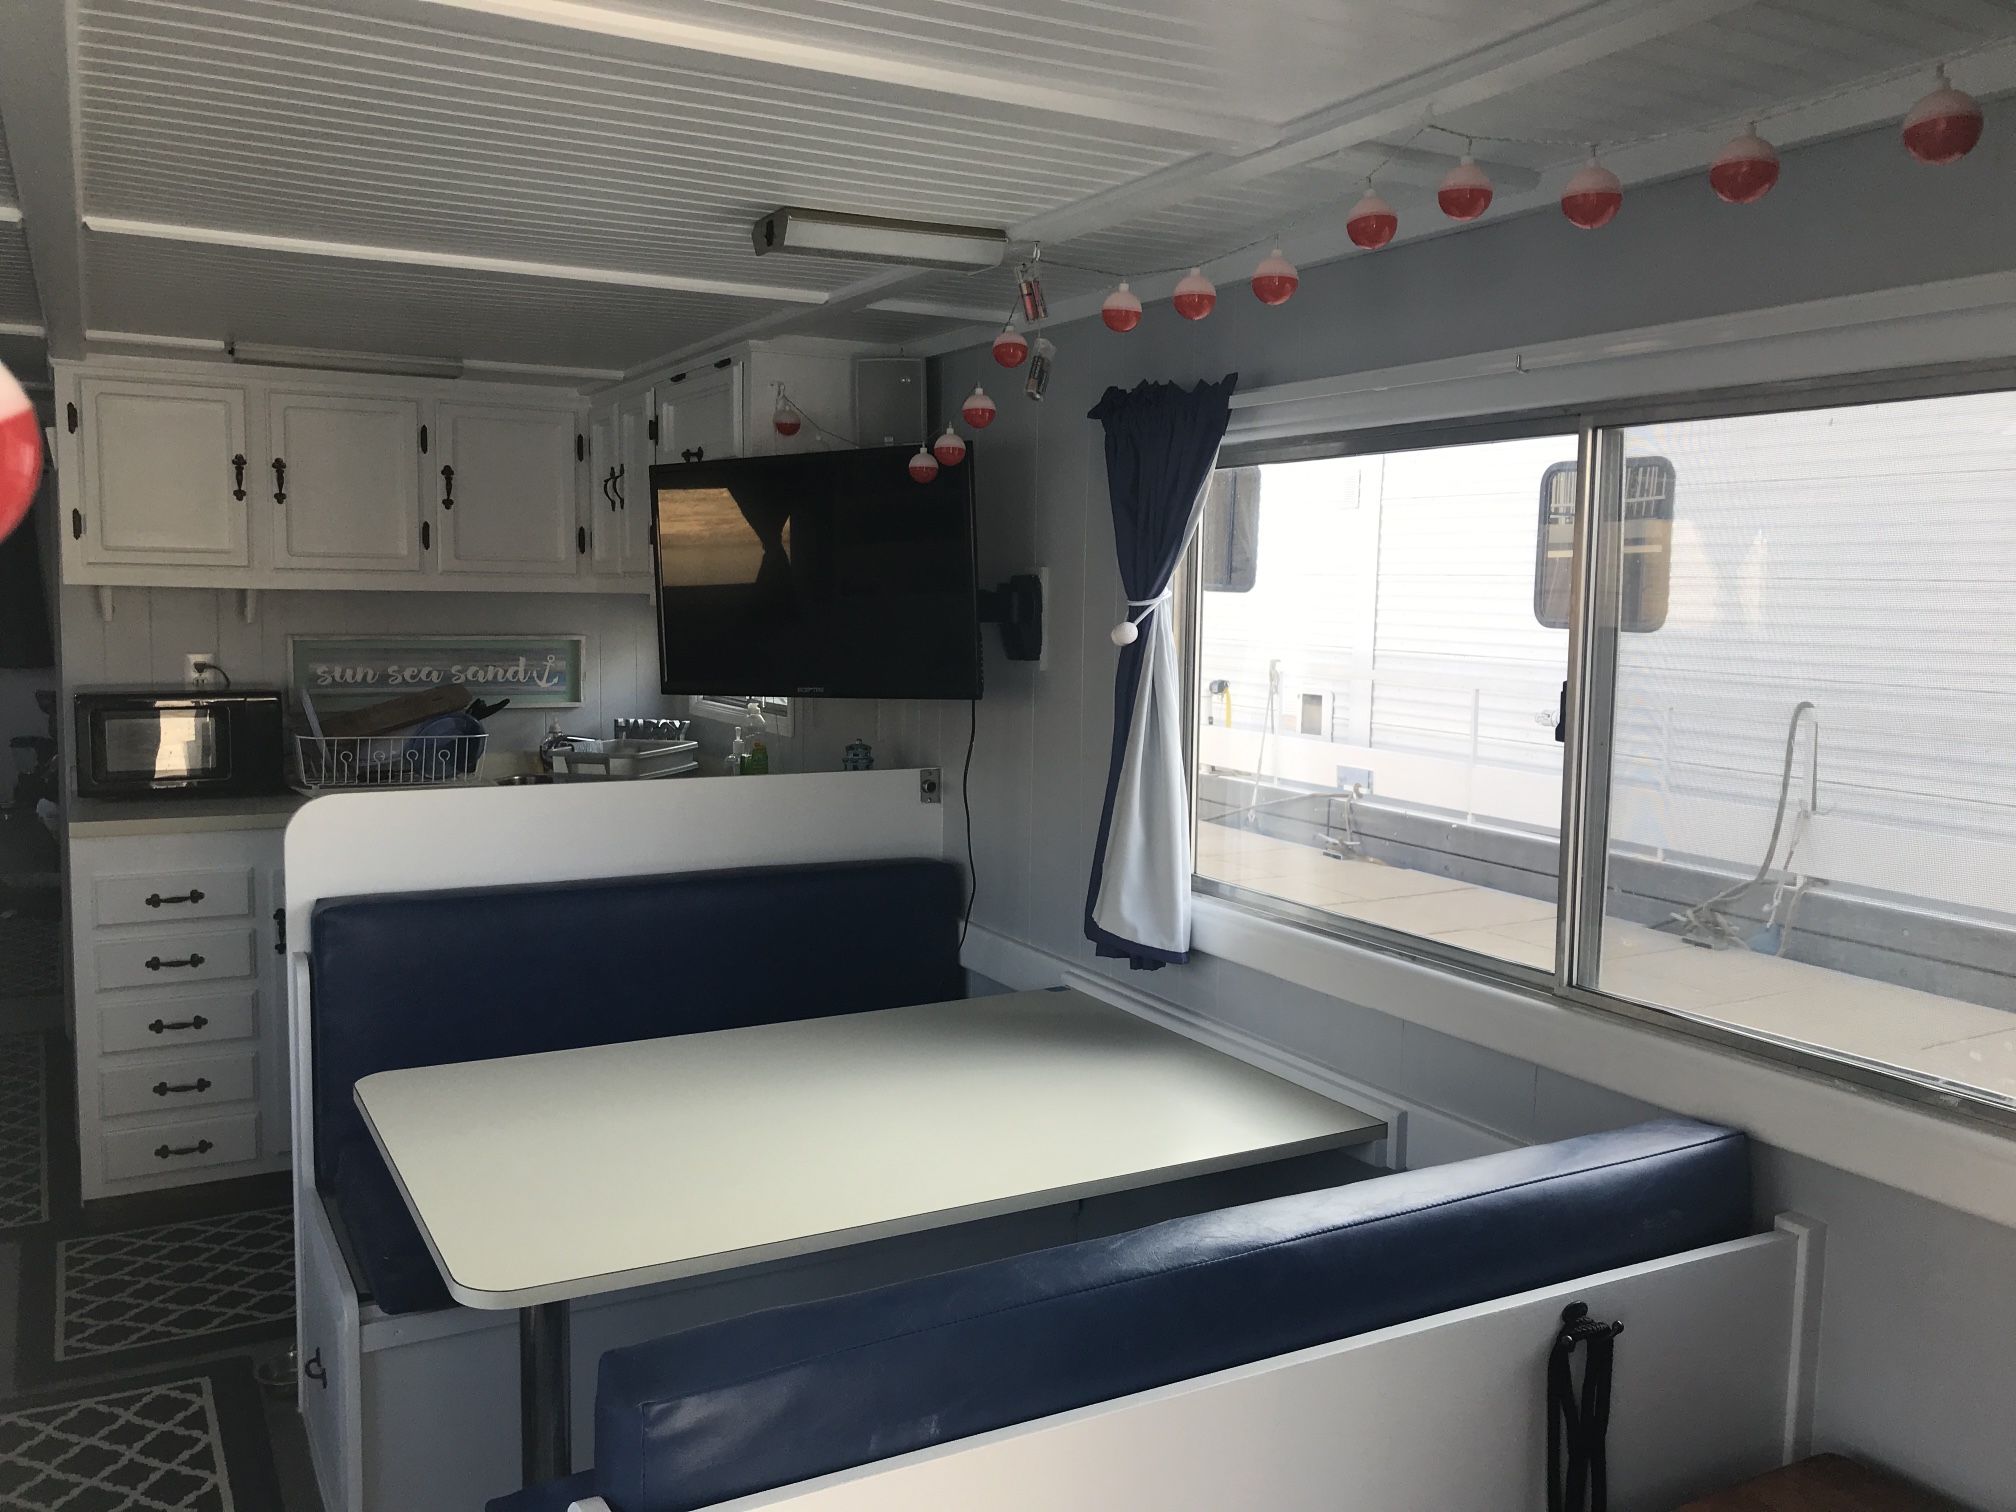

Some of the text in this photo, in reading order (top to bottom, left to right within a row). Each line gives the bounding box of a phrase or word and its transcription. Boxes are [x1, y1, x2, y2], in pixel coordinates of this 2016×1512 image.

[316, 657, 532, 685] sun sea sand
